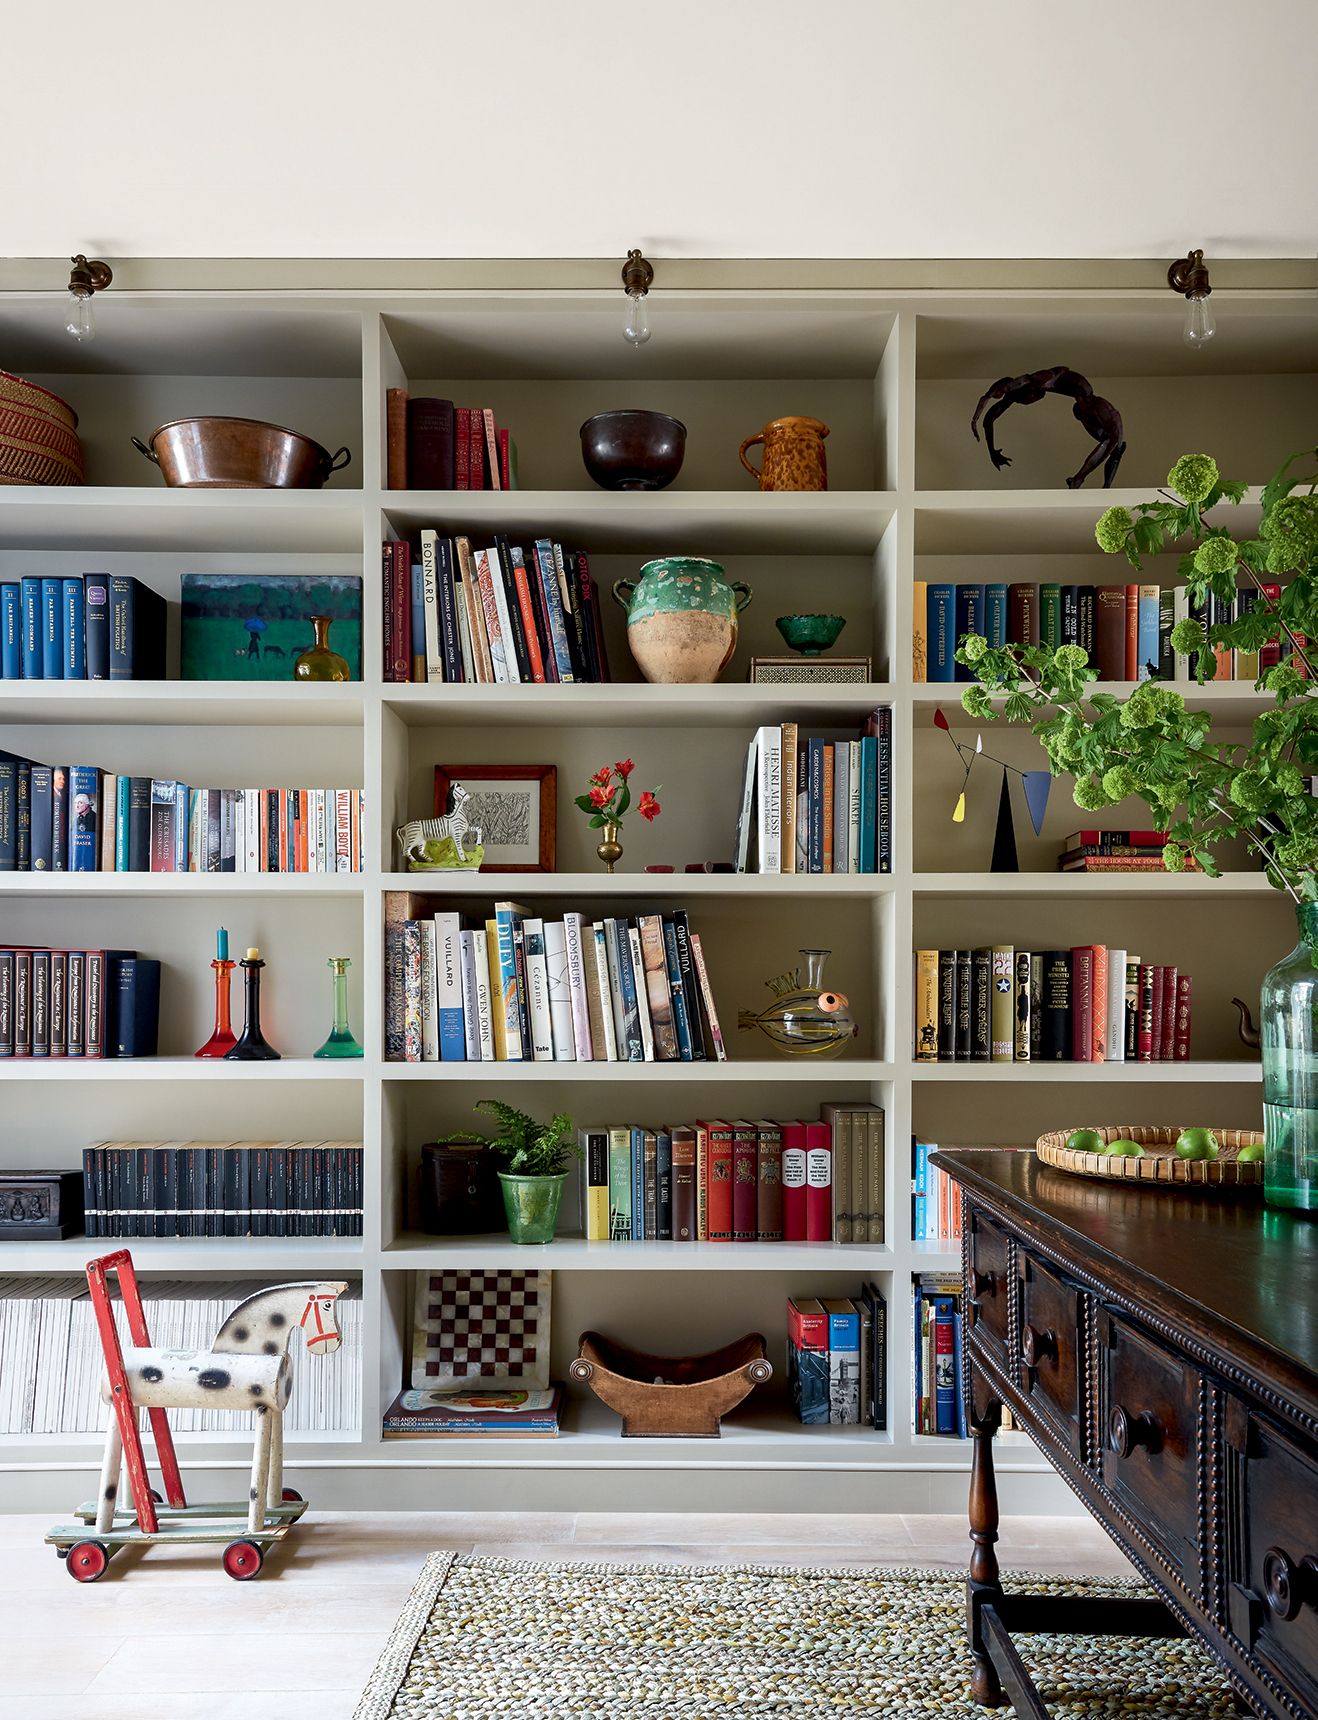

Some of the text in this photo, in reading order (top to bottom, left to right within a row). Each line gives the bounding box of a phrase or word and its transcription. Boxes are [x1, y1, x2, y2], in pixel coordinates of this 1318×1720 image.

[423, 543, 434, 604] BONNARD
[517, 572, 525, 596] ENGLISH
[578, 557, 590, 600] OTTO DIX
[552, 607, 565, 634] himself
[1071, 606, 1076, 614] IN
[771, 748, 779, 839] HENRI MATISSE
[338, 792, 348, 855] WILLIAM BOYD
[445, 936, 454, 986] VUILLARD
[497, 923, 512, 968] DUFY
[567, 917, 581, 989] BLOOMSBURY
[619, 941, 628, 974] MAVERICK
[677, 925, 690, 973] VUILLARD
[995, 960, 1012, 976] 22
[533, 967, 542, 1010] Cézanne
[943, 967, 952, 1025] NORTHERN LIGHTS
[960, 967, 969, 1030] THE SUBTLE KNIFE
[977, 967, 987, 1045] THE AMBER SPYGLASS
[1080, 956, 1089, 1010] BRITANNIA
[479, 984, 489, 1042] GWEN JOHN
